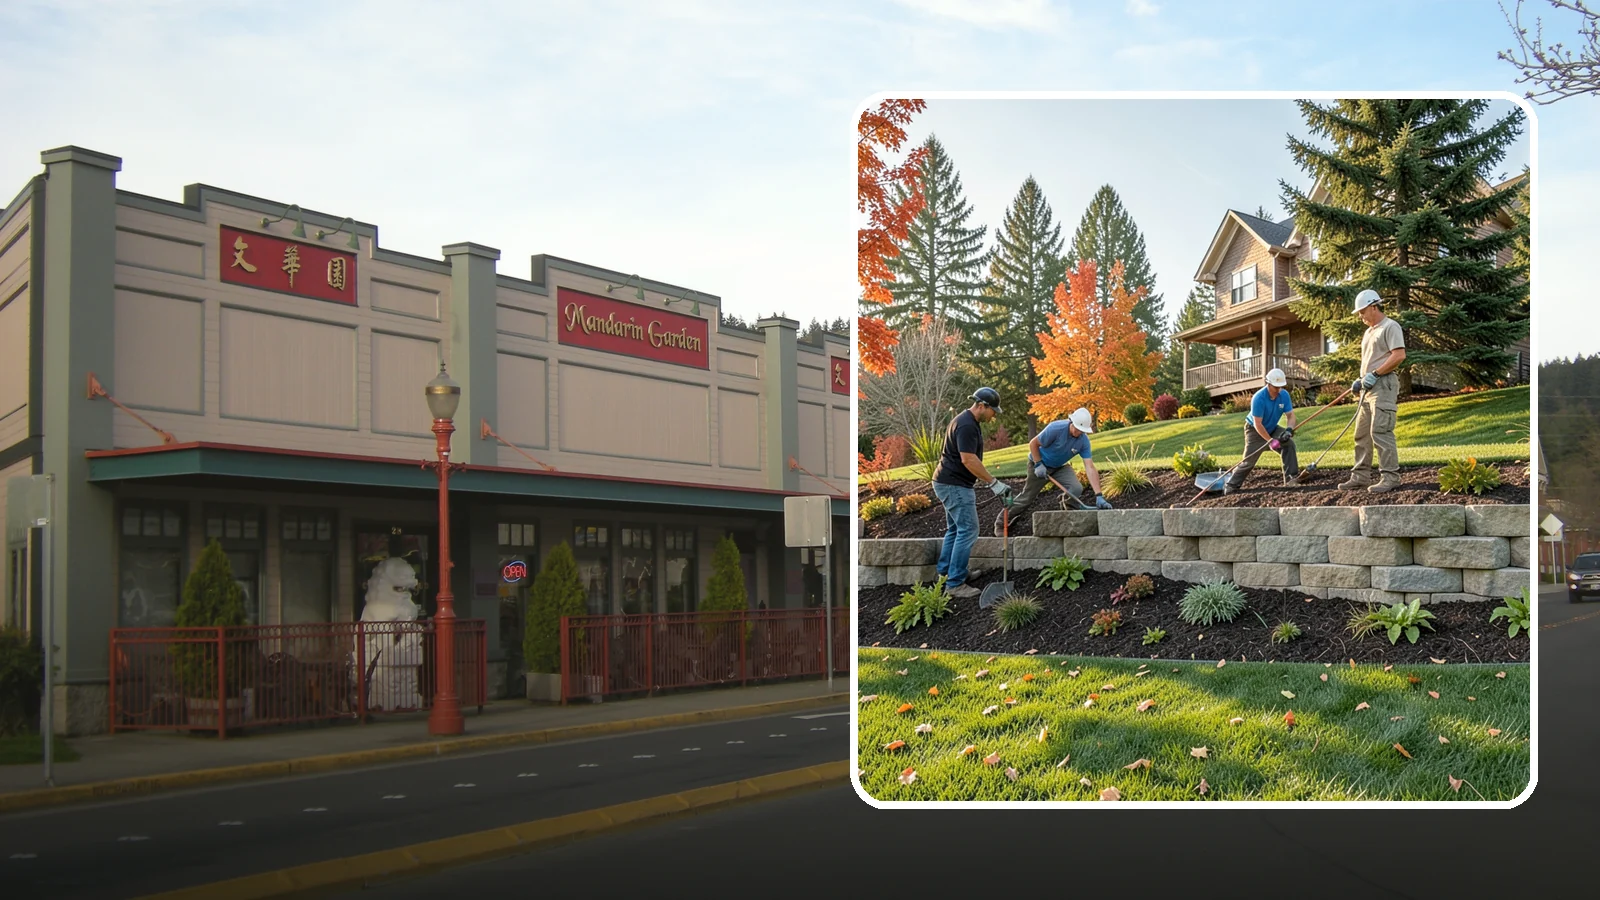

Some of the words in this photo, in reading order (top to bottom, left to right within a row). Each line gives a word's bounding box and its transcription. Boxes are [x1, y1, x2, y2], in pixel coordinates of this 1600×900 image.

[564, 302, 644, 341] Mandarin
[647, 320, 702, 353] Garden
[503, 565, 527, 578] OPEN
